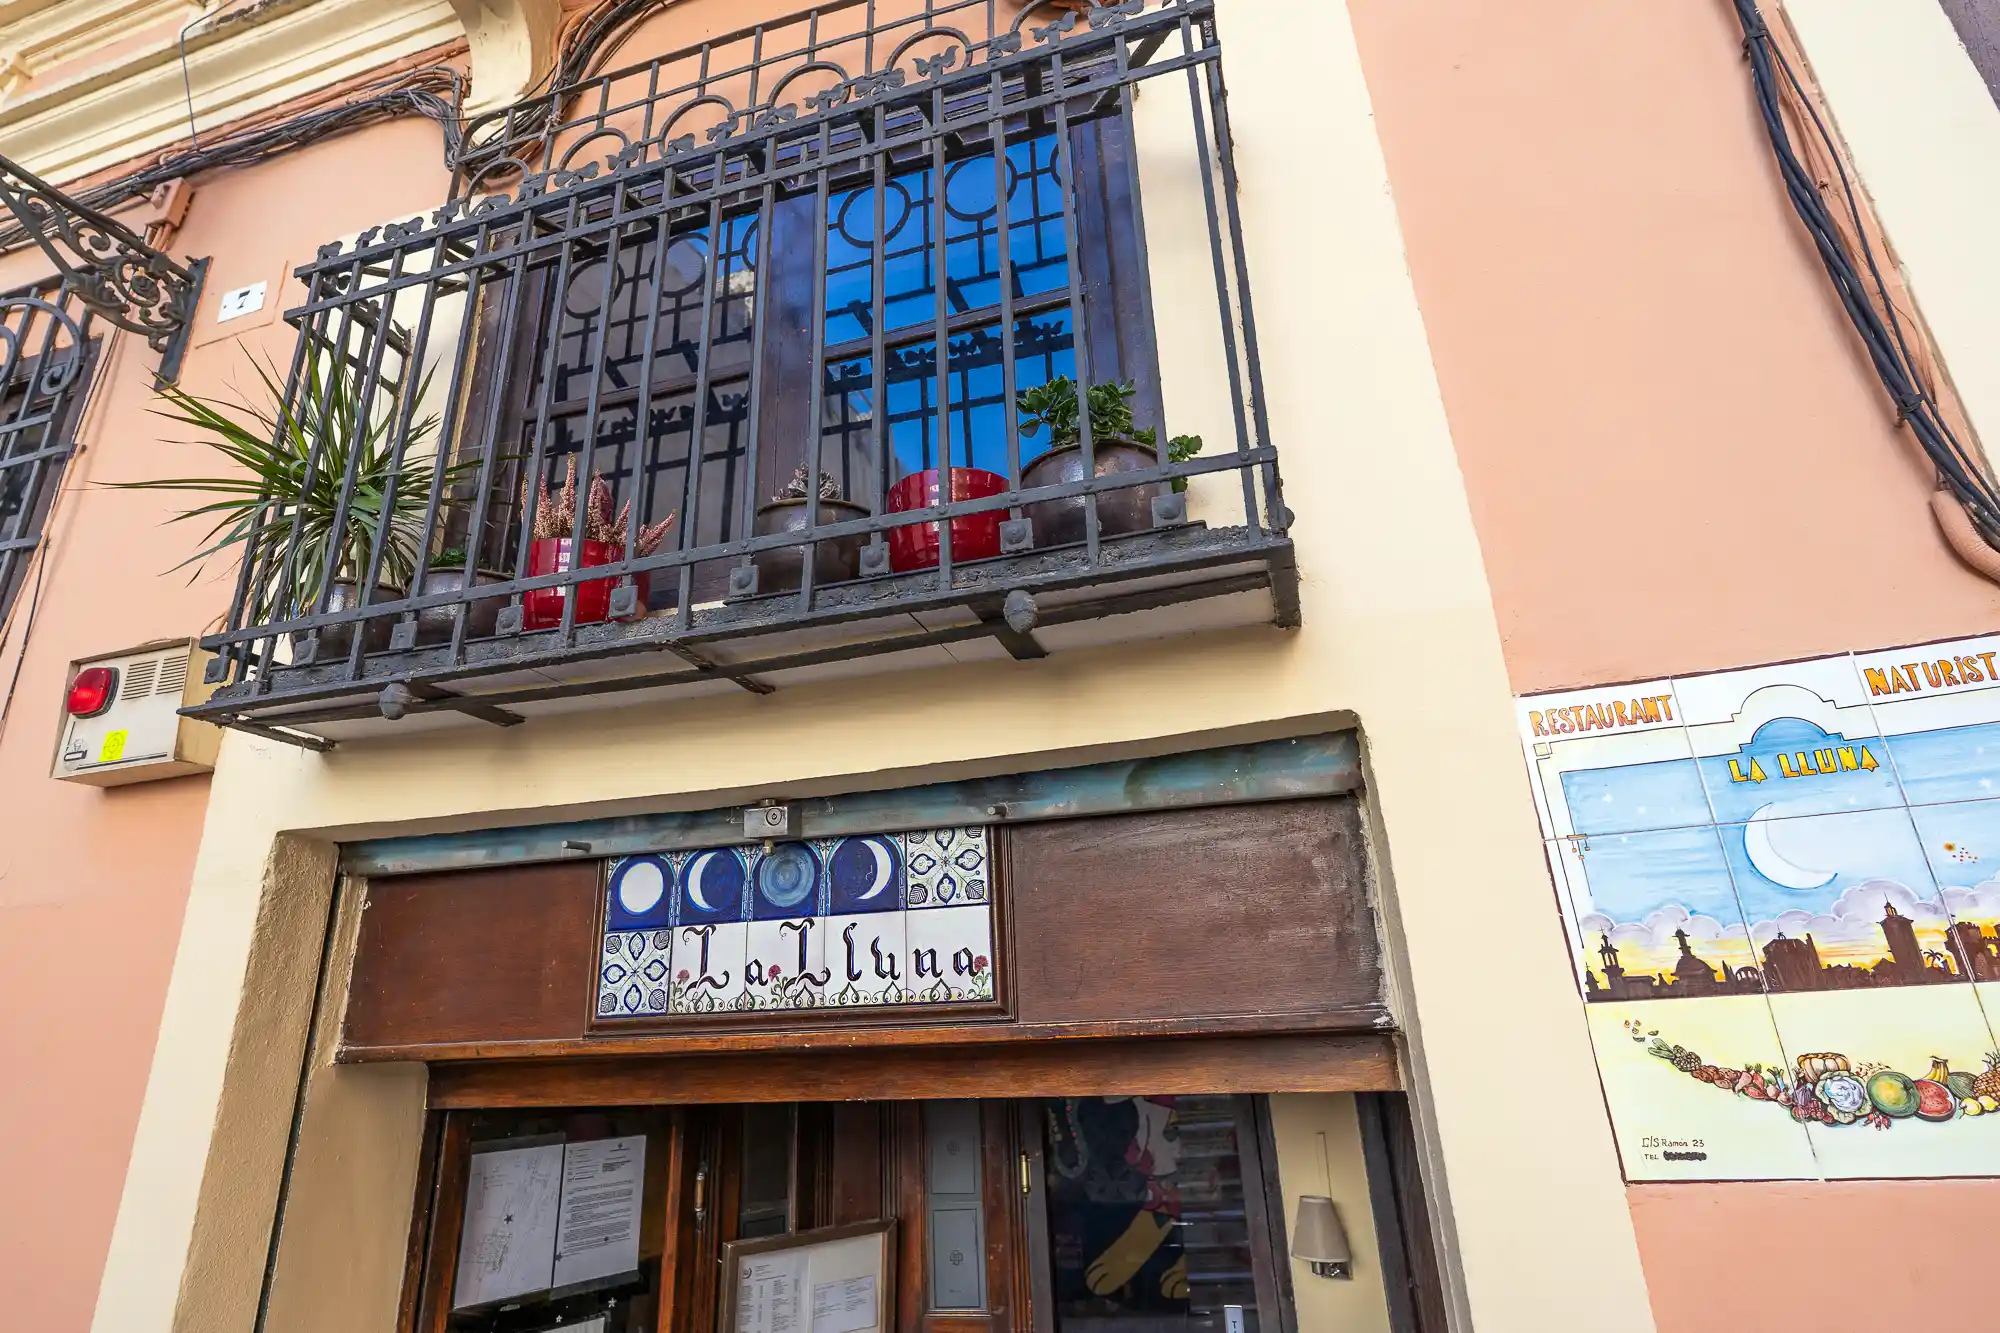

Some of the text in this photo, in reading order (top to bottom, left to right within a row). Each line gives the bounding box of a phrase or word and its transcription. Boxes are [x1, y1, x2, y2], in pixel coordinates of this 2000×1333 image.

[237, 290, 251, 310] 7
[1529, 695, 1672, 737] RESTAURANT
[1727, 745, 1880, 784] LA LLUNA
[682, 917, 983, 999] La Lluna
[1692, 1139, 1705, 1148] 23
